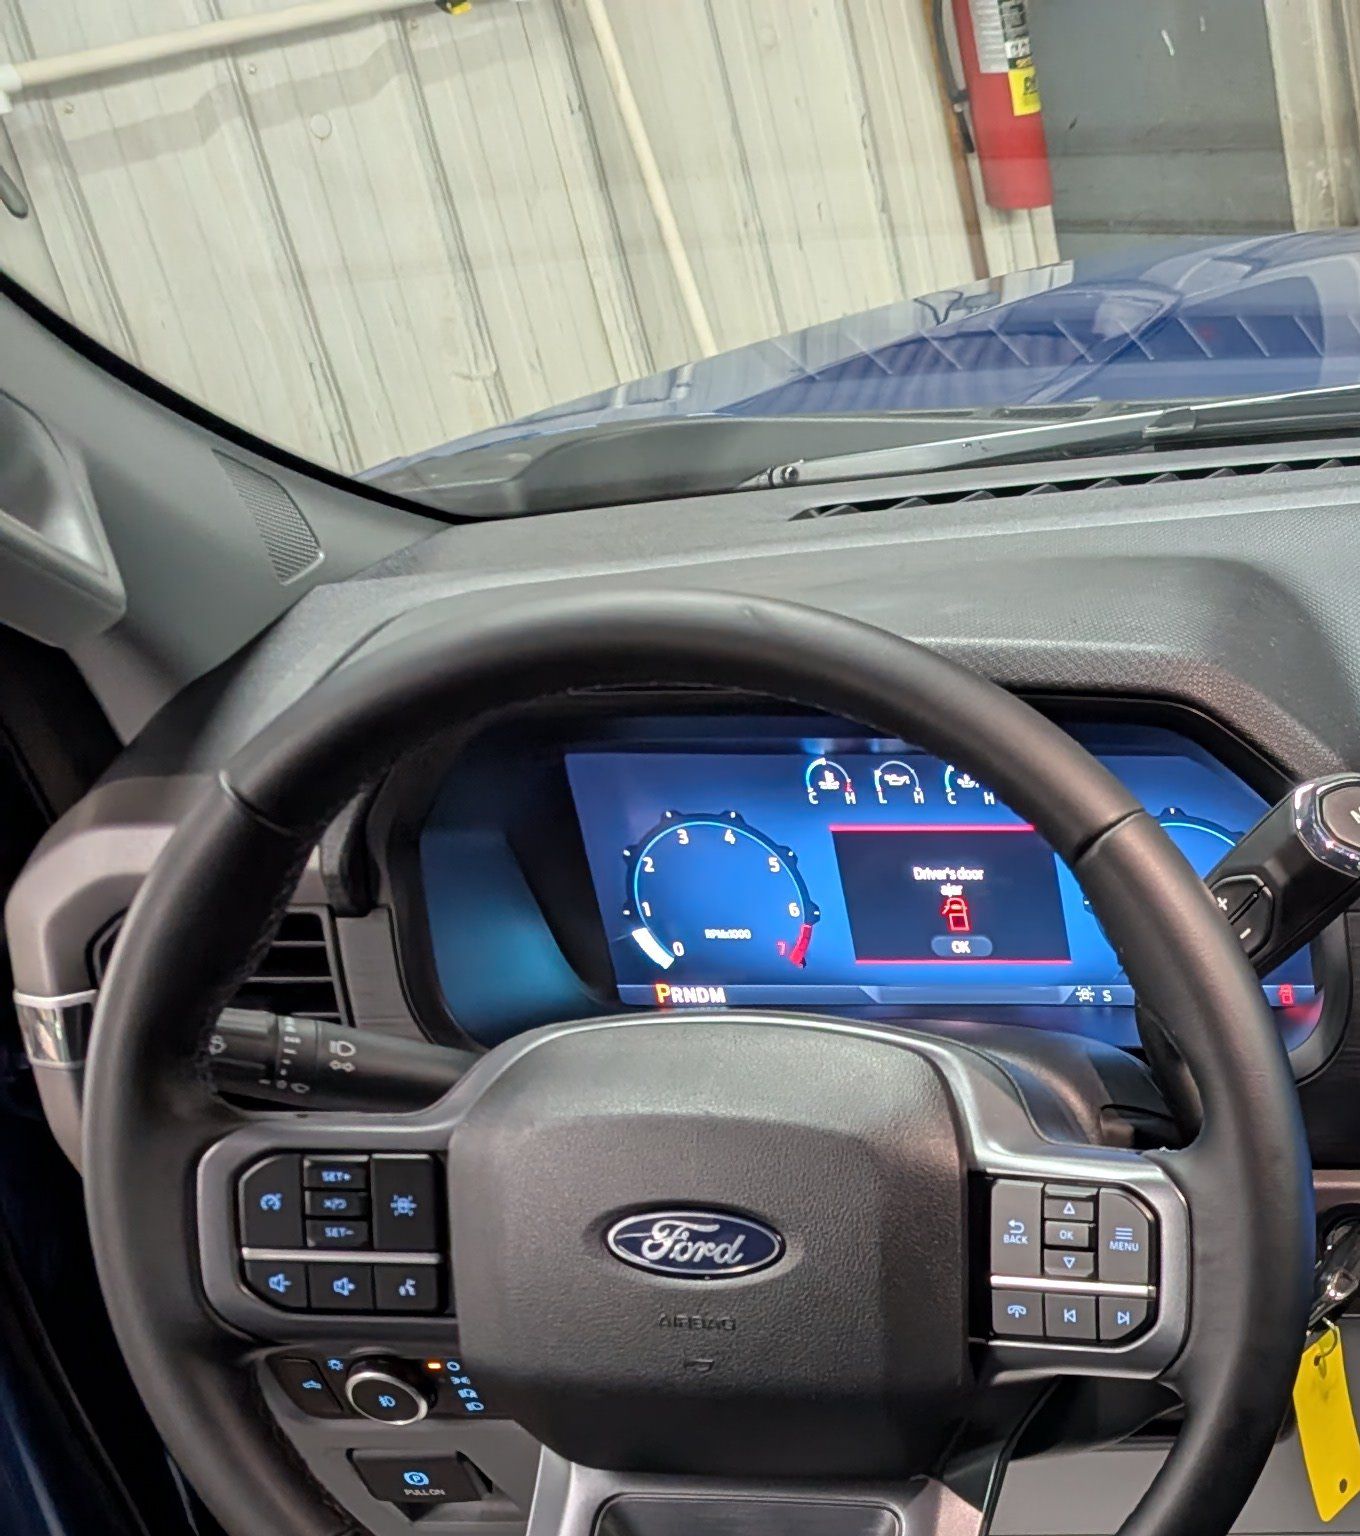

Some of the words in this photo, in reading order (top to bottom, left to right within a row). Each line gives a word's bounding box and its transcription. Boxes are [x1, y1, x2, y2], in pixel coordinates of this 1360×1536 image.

[808, 791, 819, 805] C
[845, 791, 857, 805] H
[877, 791, 888, 804] L
[913, 791, 925, 805] H
[946, 791, 957, 805] C
[983, 791, 995, 805] H
[677, 828, 689, 845] 3
[724, 828, 736, 845] 4
[642, 856, 655, 873] 2
[768, 857, 780, 873] 5
[912, 866, 957, 881] Driver's
[957, 866, 984, 881] door
[641, 901, 651, 917] 1
[788, 902, 800, 918] 6
[672, 941, 685, 957] 0
[776, 941, 787, 956] 7
[951, 940, 971, 954] OK
[1102, 989, 1112, 1002] S
[641, 1219, 747, 1265] Ford
[1003, 1234, 1029, 1245] BACK
[1059, 1229, 1074, 1241] OK
[1109, 1240, 1139, 1252] MENU
[404, 1489, 430, 1497] PULL
[430, 1489, 446, 1497] ON
